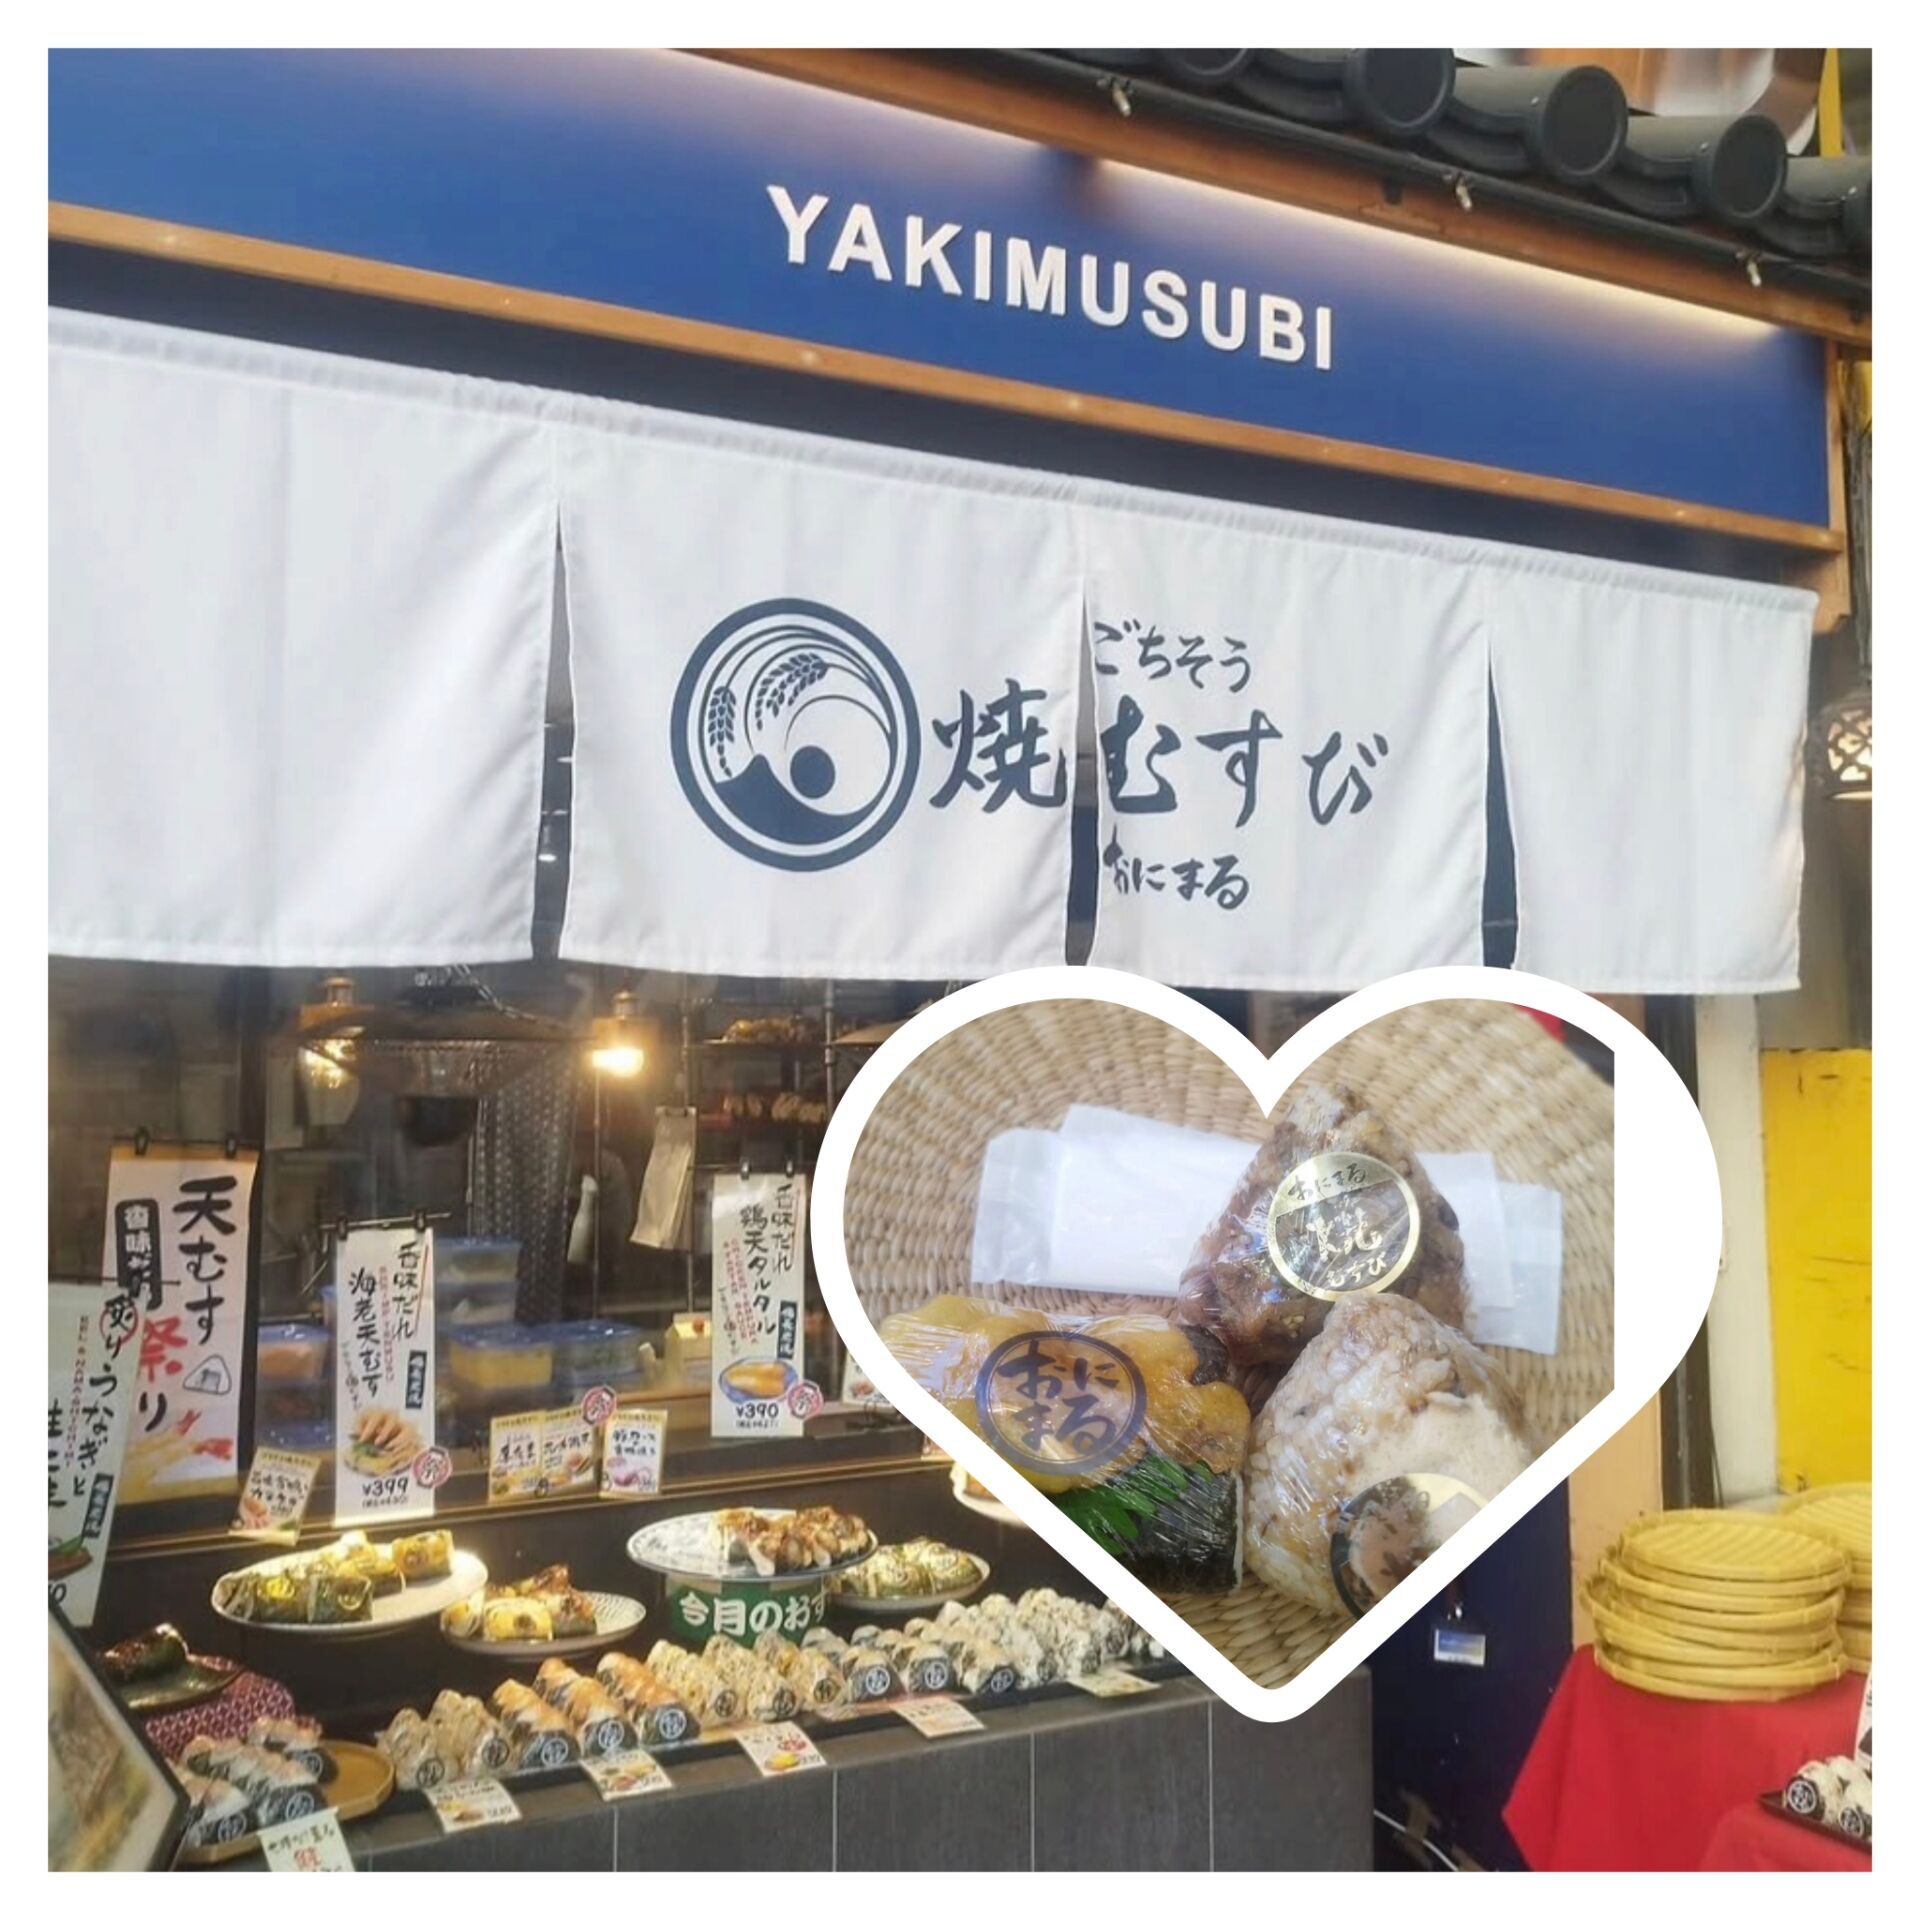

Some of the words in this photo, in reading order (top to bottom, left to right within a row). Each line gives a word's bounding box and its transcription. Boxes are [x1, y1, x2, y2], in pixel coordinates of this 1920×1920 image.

[766, 184, 1333, 371] YAKIMUSUBI
[1094, 617, 1253, 692] ごちそう
[1103, 823, 1251, 911] おにまる
[172, 1175, 238, 1347] 天むす
[740, 1202, 777, 1335] 鶏天タルタル
[348, 1266, 383, 1398] 海老天むす
[736, 1402, 779, 1419] ¥390
